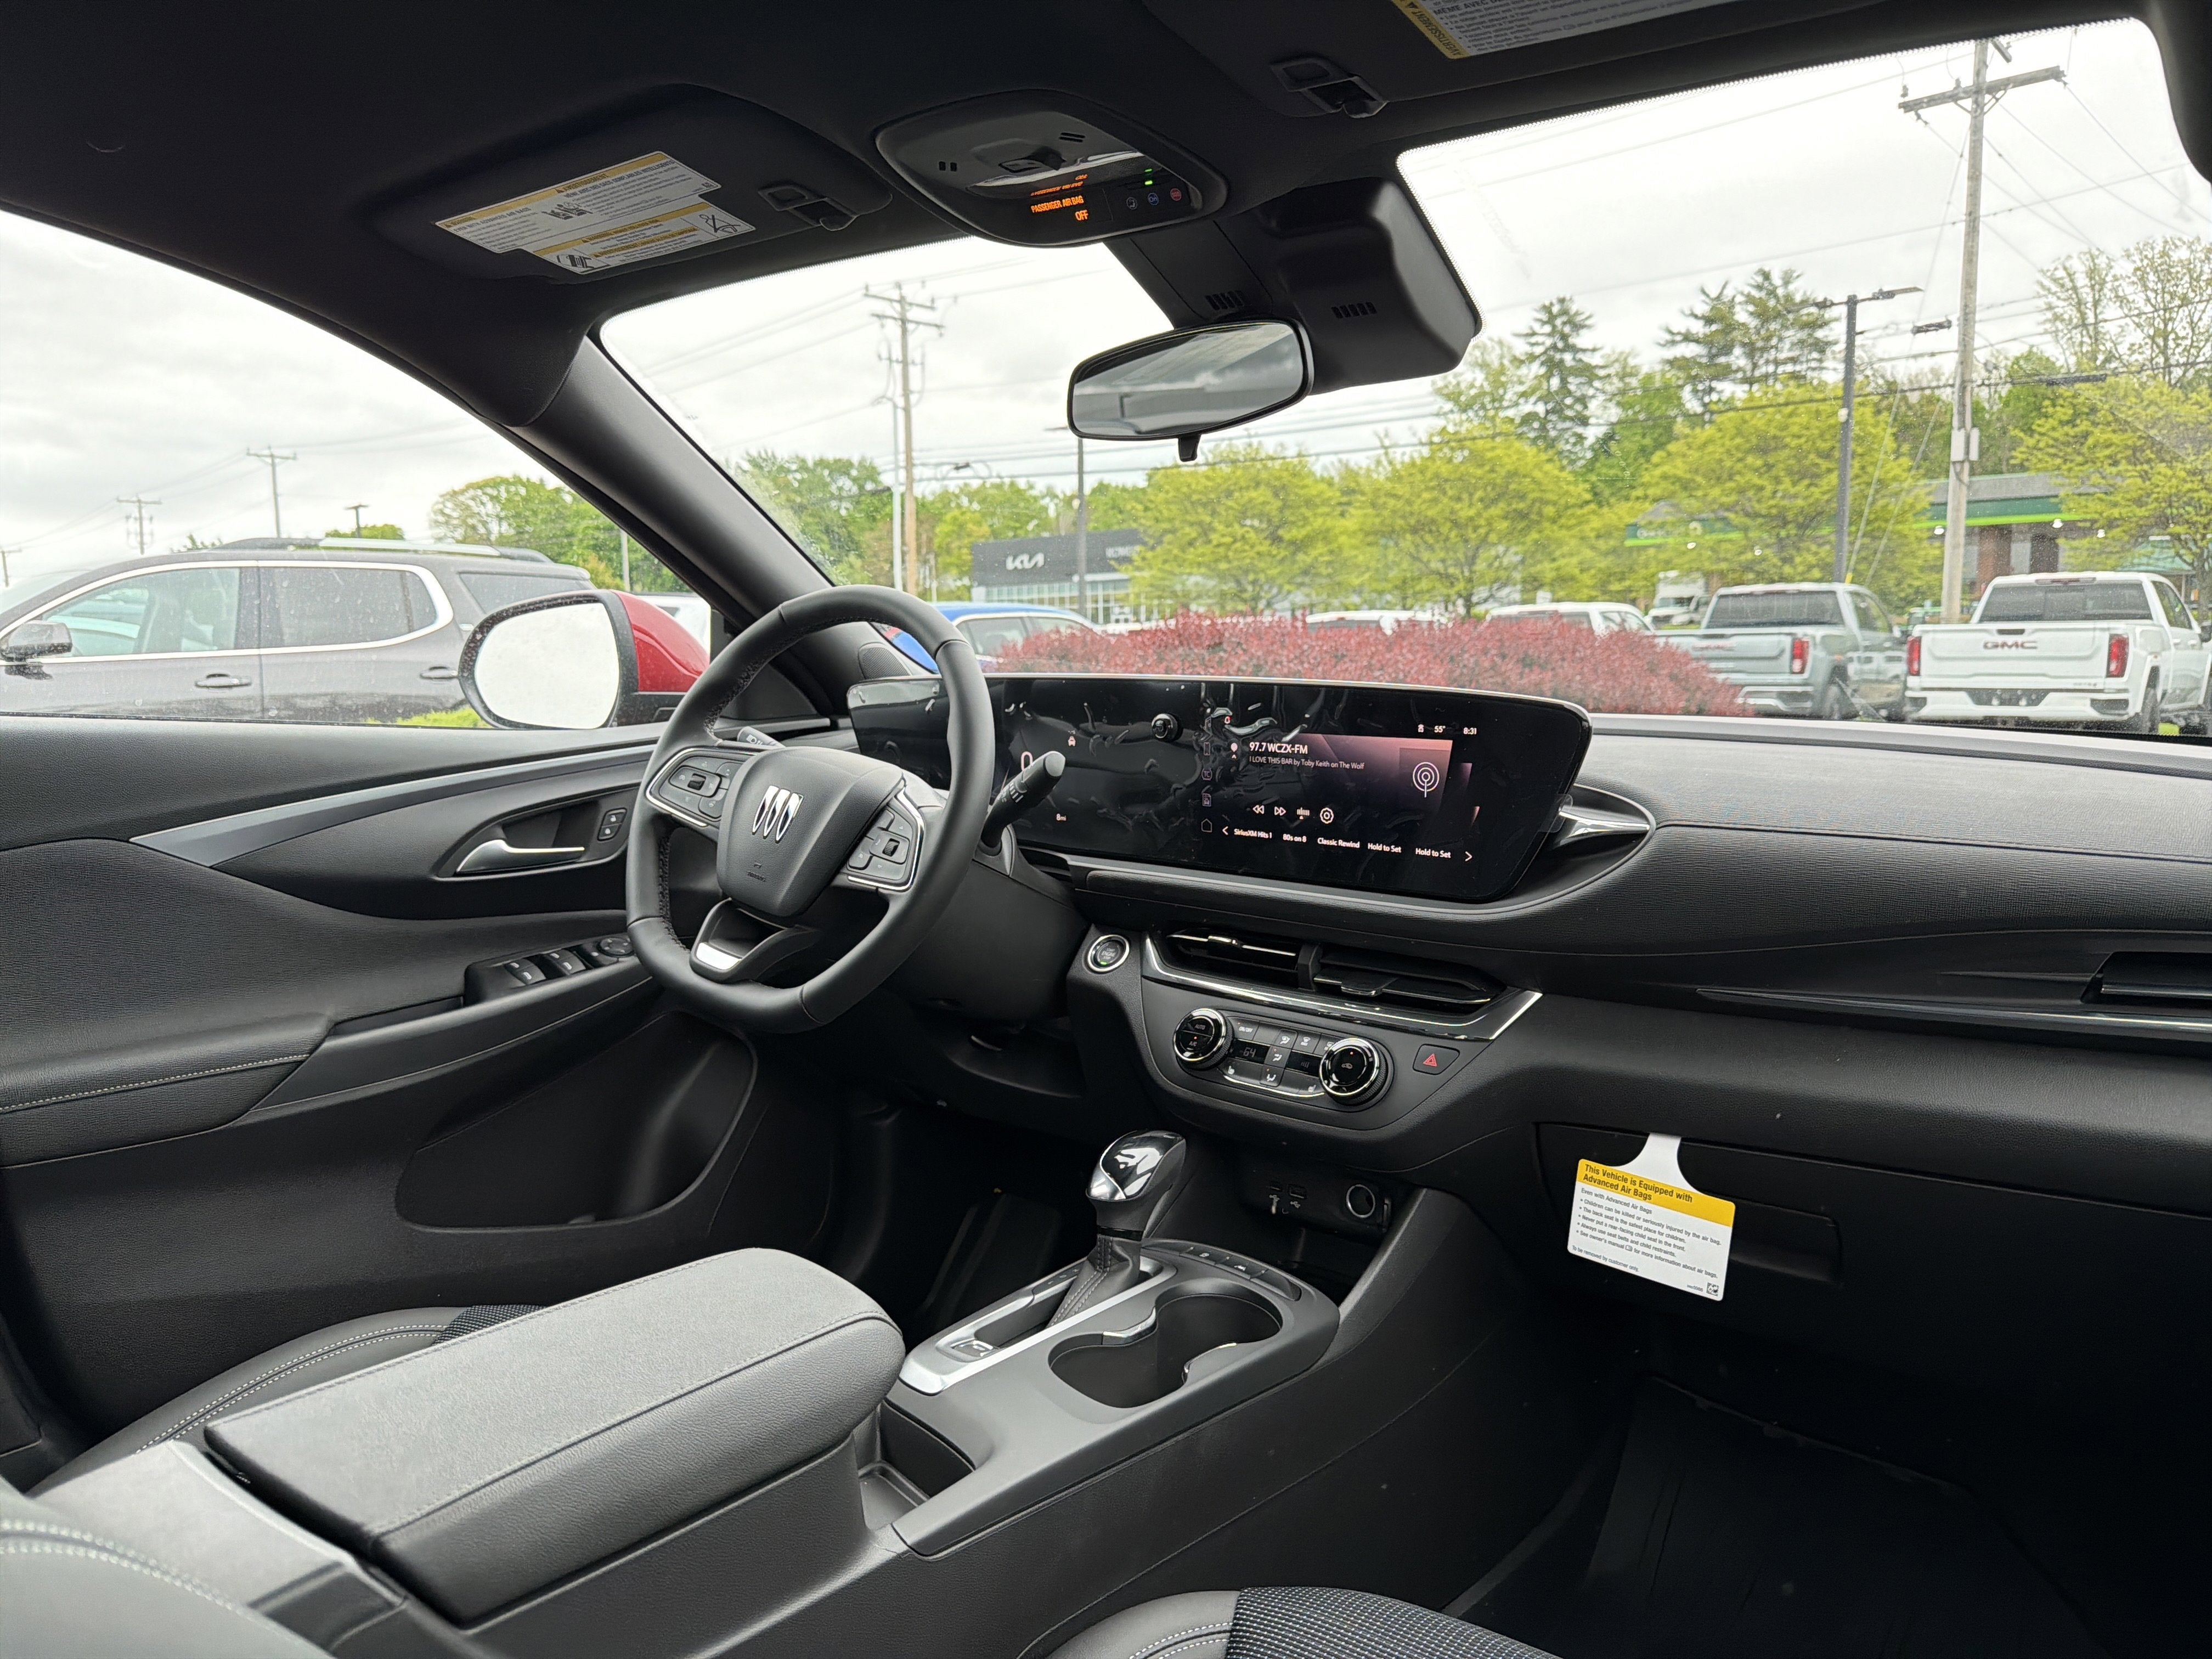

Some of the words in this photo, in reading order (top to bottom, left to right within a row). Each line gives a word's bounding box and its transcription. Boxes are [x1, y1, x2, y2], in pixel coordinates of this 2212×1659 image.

[1031, 200, 1062, 213] PASSENGER
[1063, 199, 1073, 207] AIR
[1072, 195, 1084, 205] BAG
[1075, 210, 1089, 221] OFF
[1983, 640, 2038, 650] GMC
[1463, 727, 1477, 735] 8:31
[1249, 742, 1266, 752] 97.7
[1267, 743, 1308, 754] WCZX-FM
[1301, 759, 1314, 768] Toby
[1234, 828, 1257, 837] SiriusXM
[1317, 837, 1338, 846] Classic
[1338, 839, 1360, 848] Rewind
[1368, 843, 1383, 851] Hold
[1391, 845, 1402, 853] Set
[1415, 848, 1431, 856] Hold
[1440, 850, 1451, 859] Set
[1243, 1047, 1257, 1058] 64
[1583, 1173, 1620, 1190] Advanced
[1620, 1184, 1632, 1197] Air
[1633, 1188, 1652, 1202] Bags
[1585, 1164, 1600, 1176] This
[1602, 1169, 1628, 1184] Vehicle
[1629, 1177, 1637, 1186] is
[1638, 1180, 1674, 1198] Equipped
[1675, 1192, 1693, 1203] with
[1581, 1187, 1593, 1196] Even
[1605, 1195, 1630, 1208] Advanced
[1639, 1205, 1652, 1215] Bags
[1581, 1222, 1597, 1232] Always
[1582, 1214, 1595, 1223] Never
[1608, 1223, 1634, 1237] rear-facing
[1584, 1199, 1604, 1209] Children
[1621, 1210, 1635, 1220] killed
[1642, 1218, 1665, 1229] seriously
[1665, 1223, 1684, 1234] injured
[1709, 1237, 1722, 1246] bag.
[1592, 1209, 1604, 1217] back
[1628, 1222, 1643, 1231] safest
[1643, 1226, 1657, 1234] place
[1583, 1250, 1602, 1260] removed
[1608, 1258, 1629, 1268] customer
[1607, 1240, 1625, 1249] manual
[1654, 1254, 1681, 1267] information
[1704, 1269, 1718, 1279] bags.
